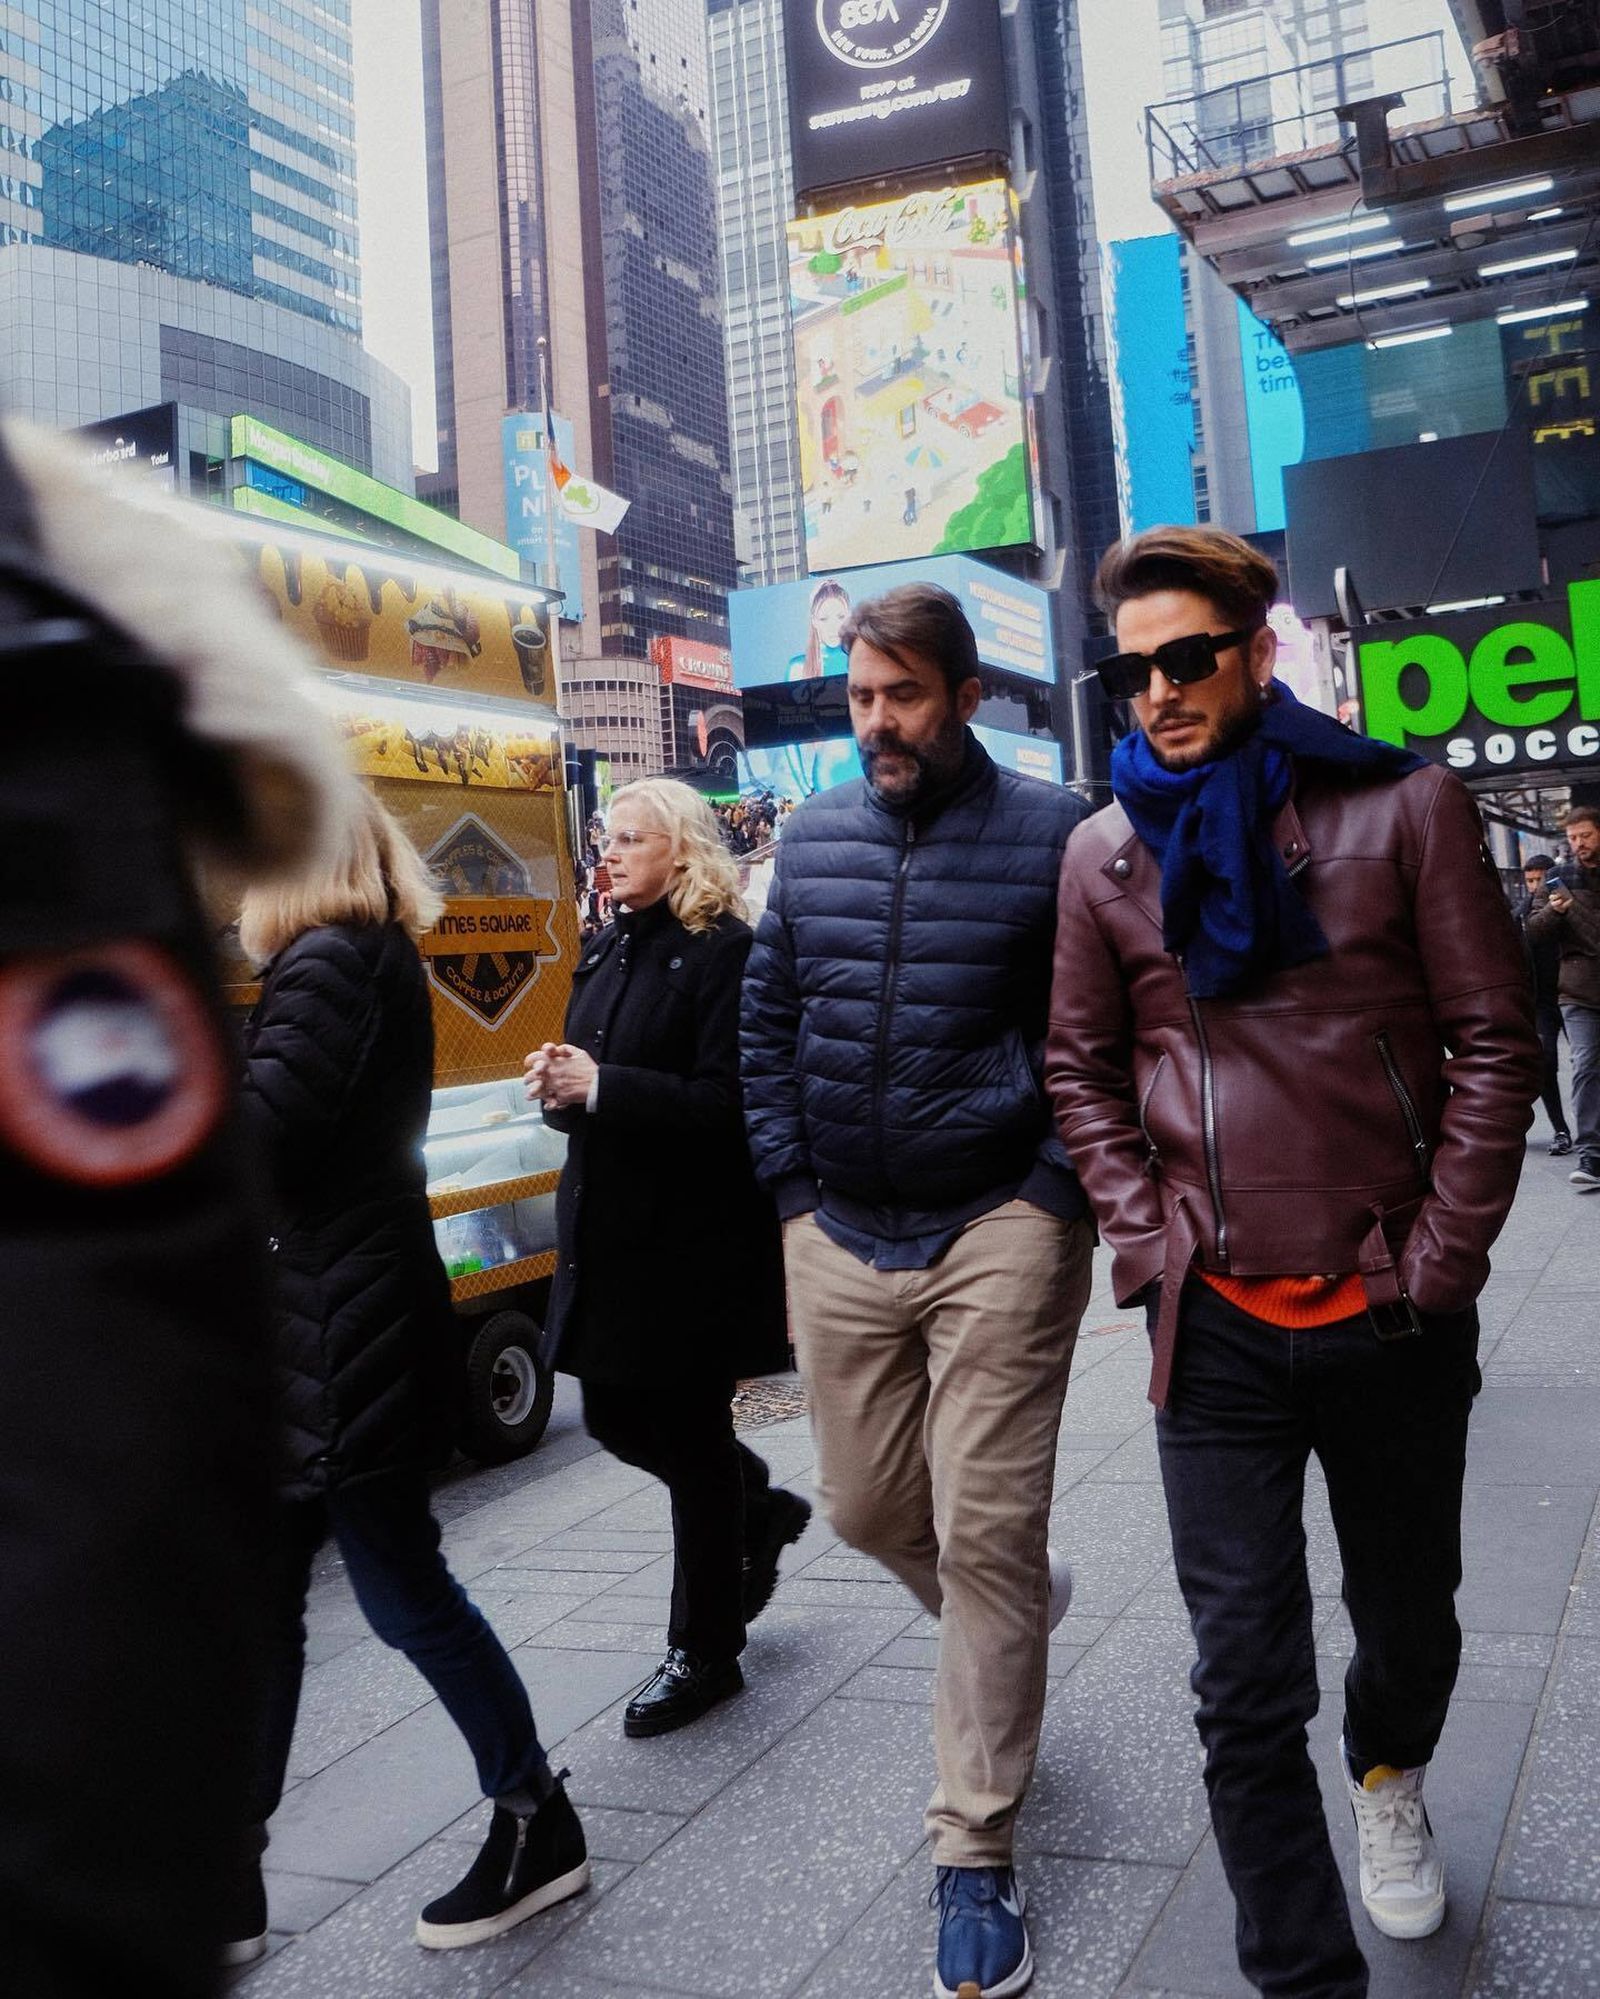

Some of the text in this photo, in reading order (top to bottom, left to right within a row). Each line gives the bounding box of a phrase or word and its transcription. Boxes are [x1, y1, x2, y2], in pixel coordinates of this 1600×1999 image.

[480, 913, 532, 935] SQUARE
[446, 960, 525, 1003] COFFEE & DONUTS
